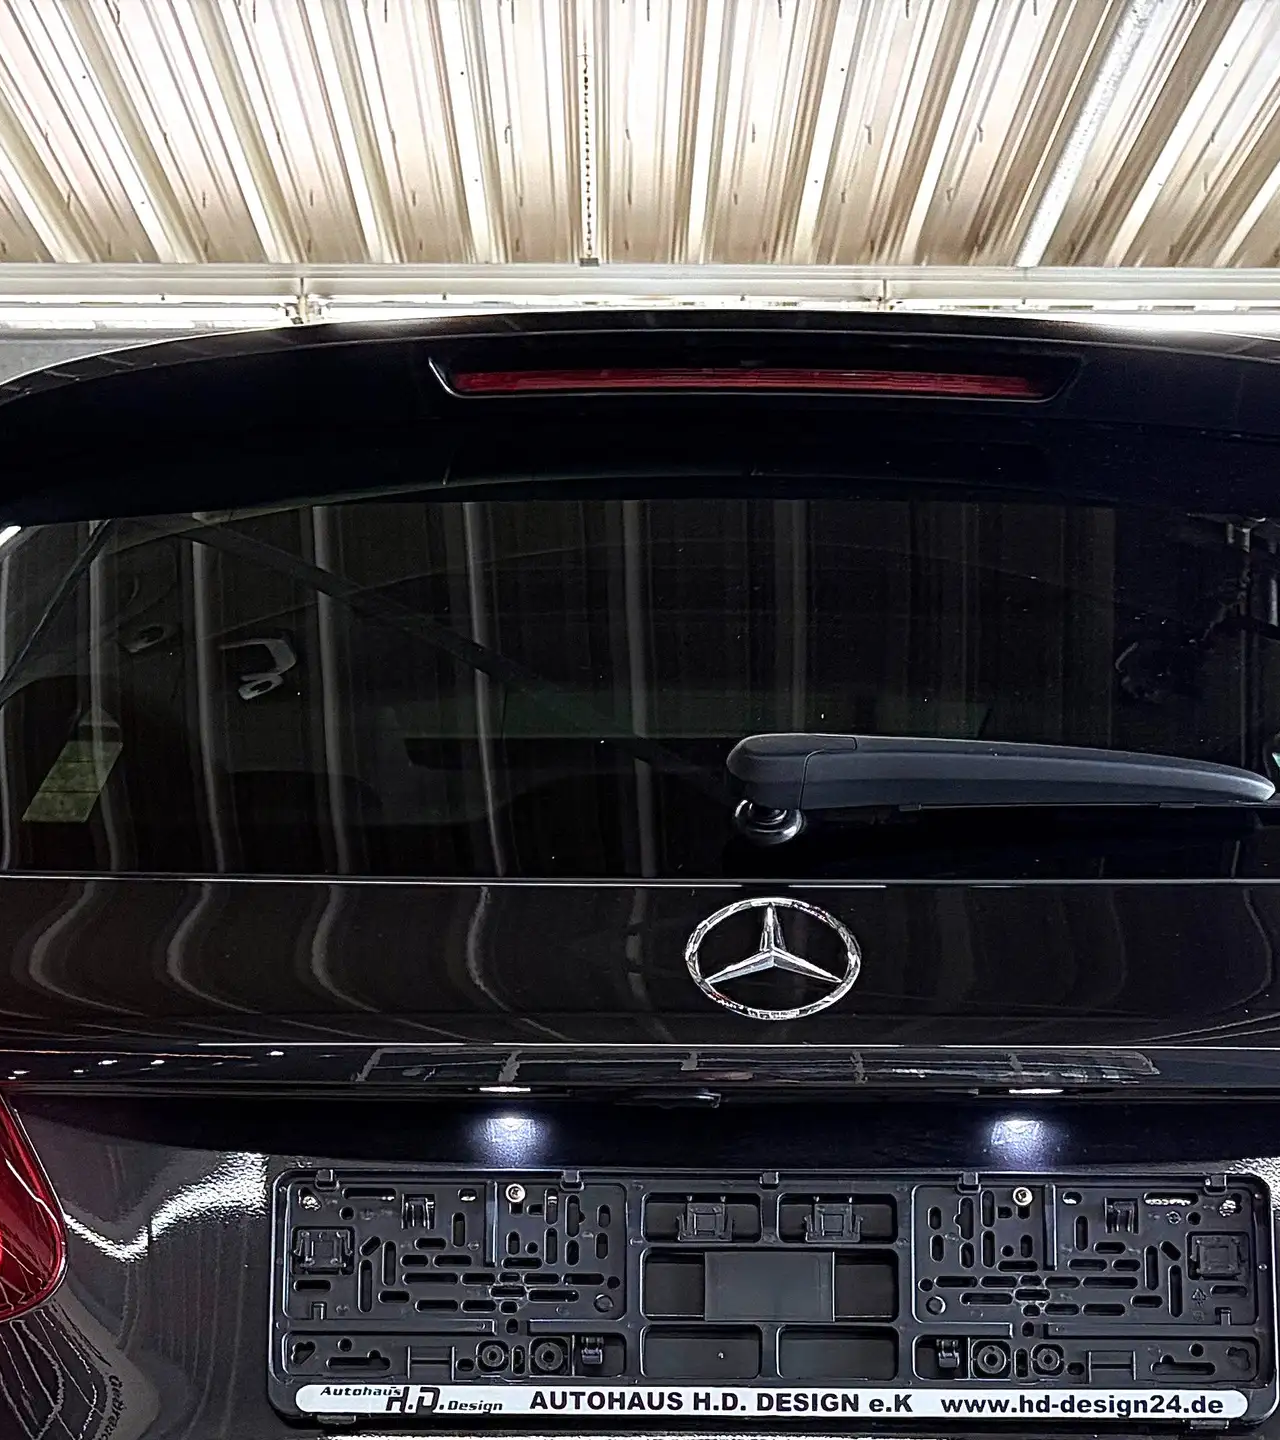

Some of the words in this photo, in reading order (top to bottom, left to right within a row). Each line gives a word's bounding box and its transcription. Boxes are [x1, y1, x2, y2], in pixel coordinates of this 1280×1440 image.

[320, 1386, 402, 1396] Autohaus
[447, 1400, 503, 1414] Design
[530, 1391, 683, 1411] AUTOHAUS
[694, 1391, 747, 1411] H.D.
[757, 1392, 859, 1412] DESIGN
[868, 1392, 913, 1412] e.K
[941, 1394, 1224, 1418] www.hd-design24.de
